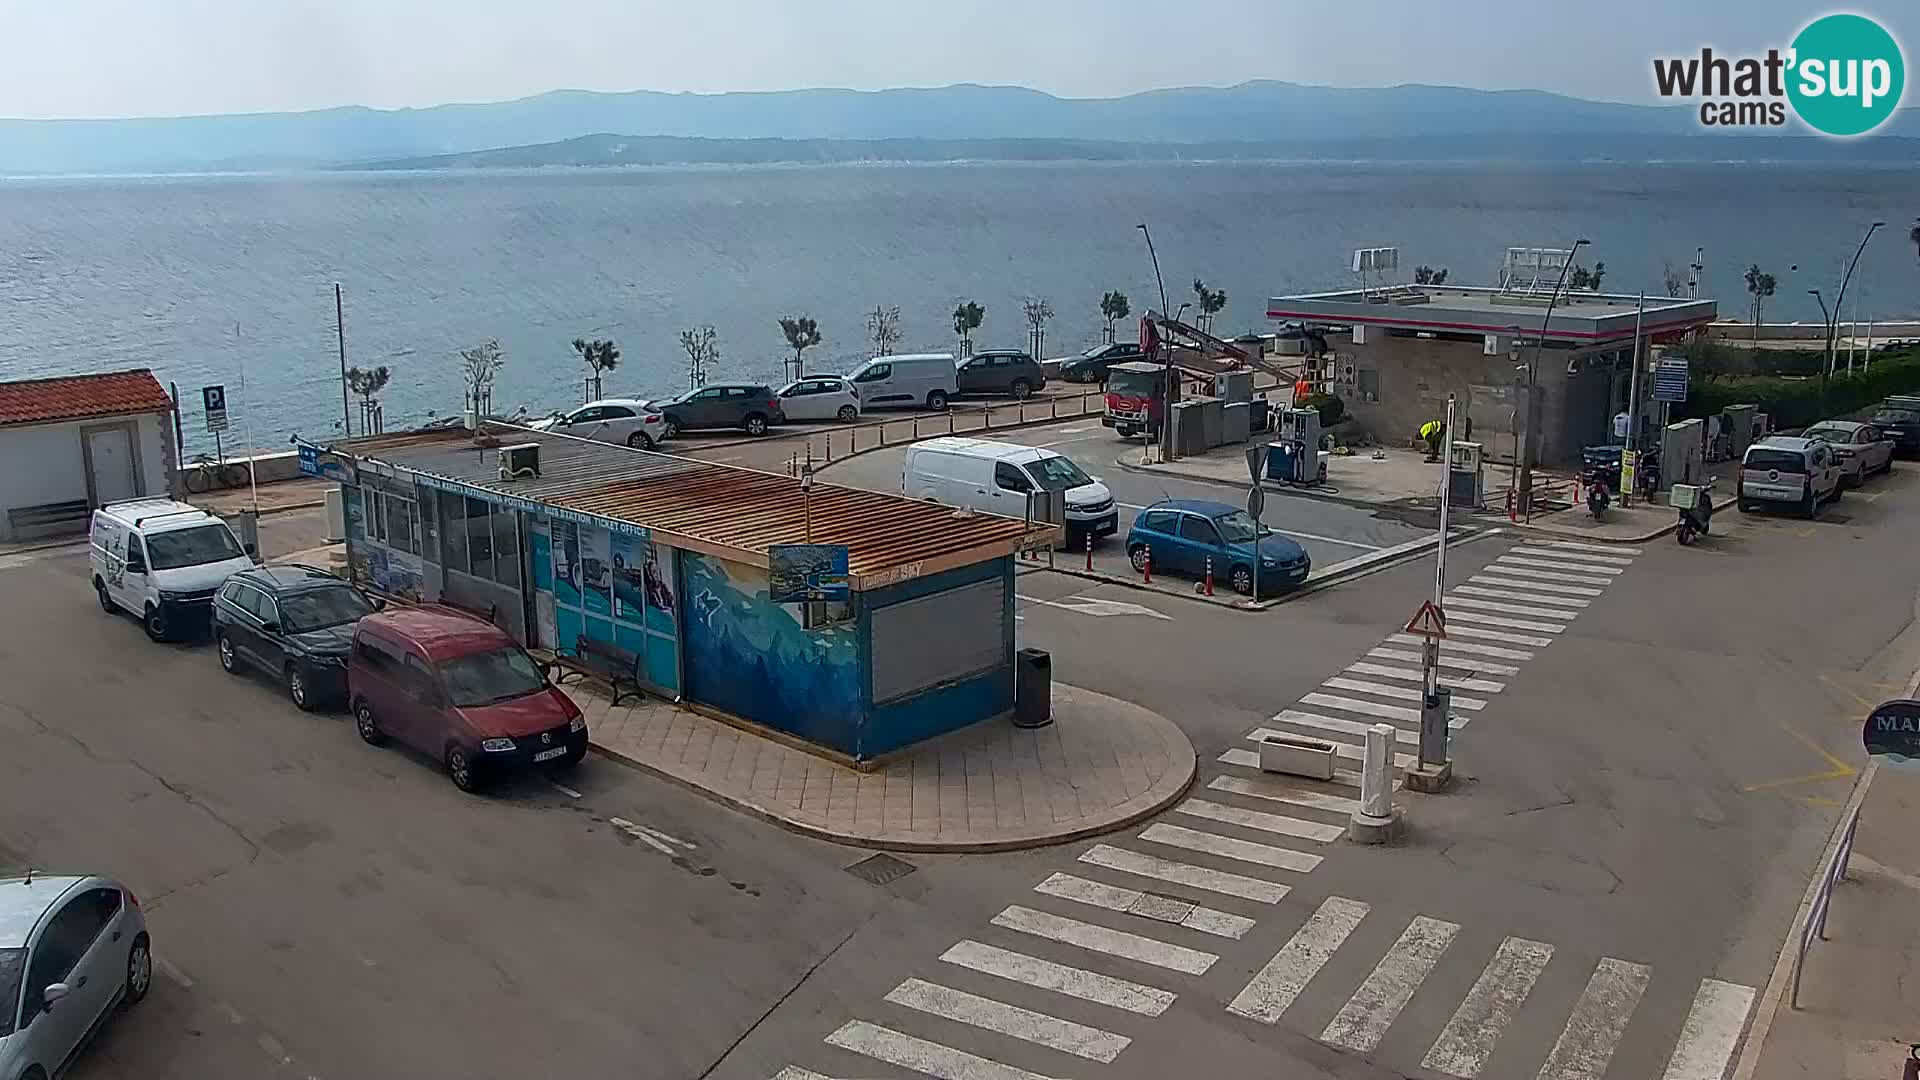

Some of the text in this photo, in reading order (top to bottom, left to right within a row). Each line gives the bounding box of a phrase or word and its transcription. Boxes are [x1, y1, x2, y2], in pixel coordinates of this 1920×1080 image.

[208, 390, 220, 407] P
[560, 509, 592, 525] STATION
[594, 517, 619, 531] TICKET
[619, 523, 647, 537] OFFICE
[1876, 715, 1920, 732] MA
